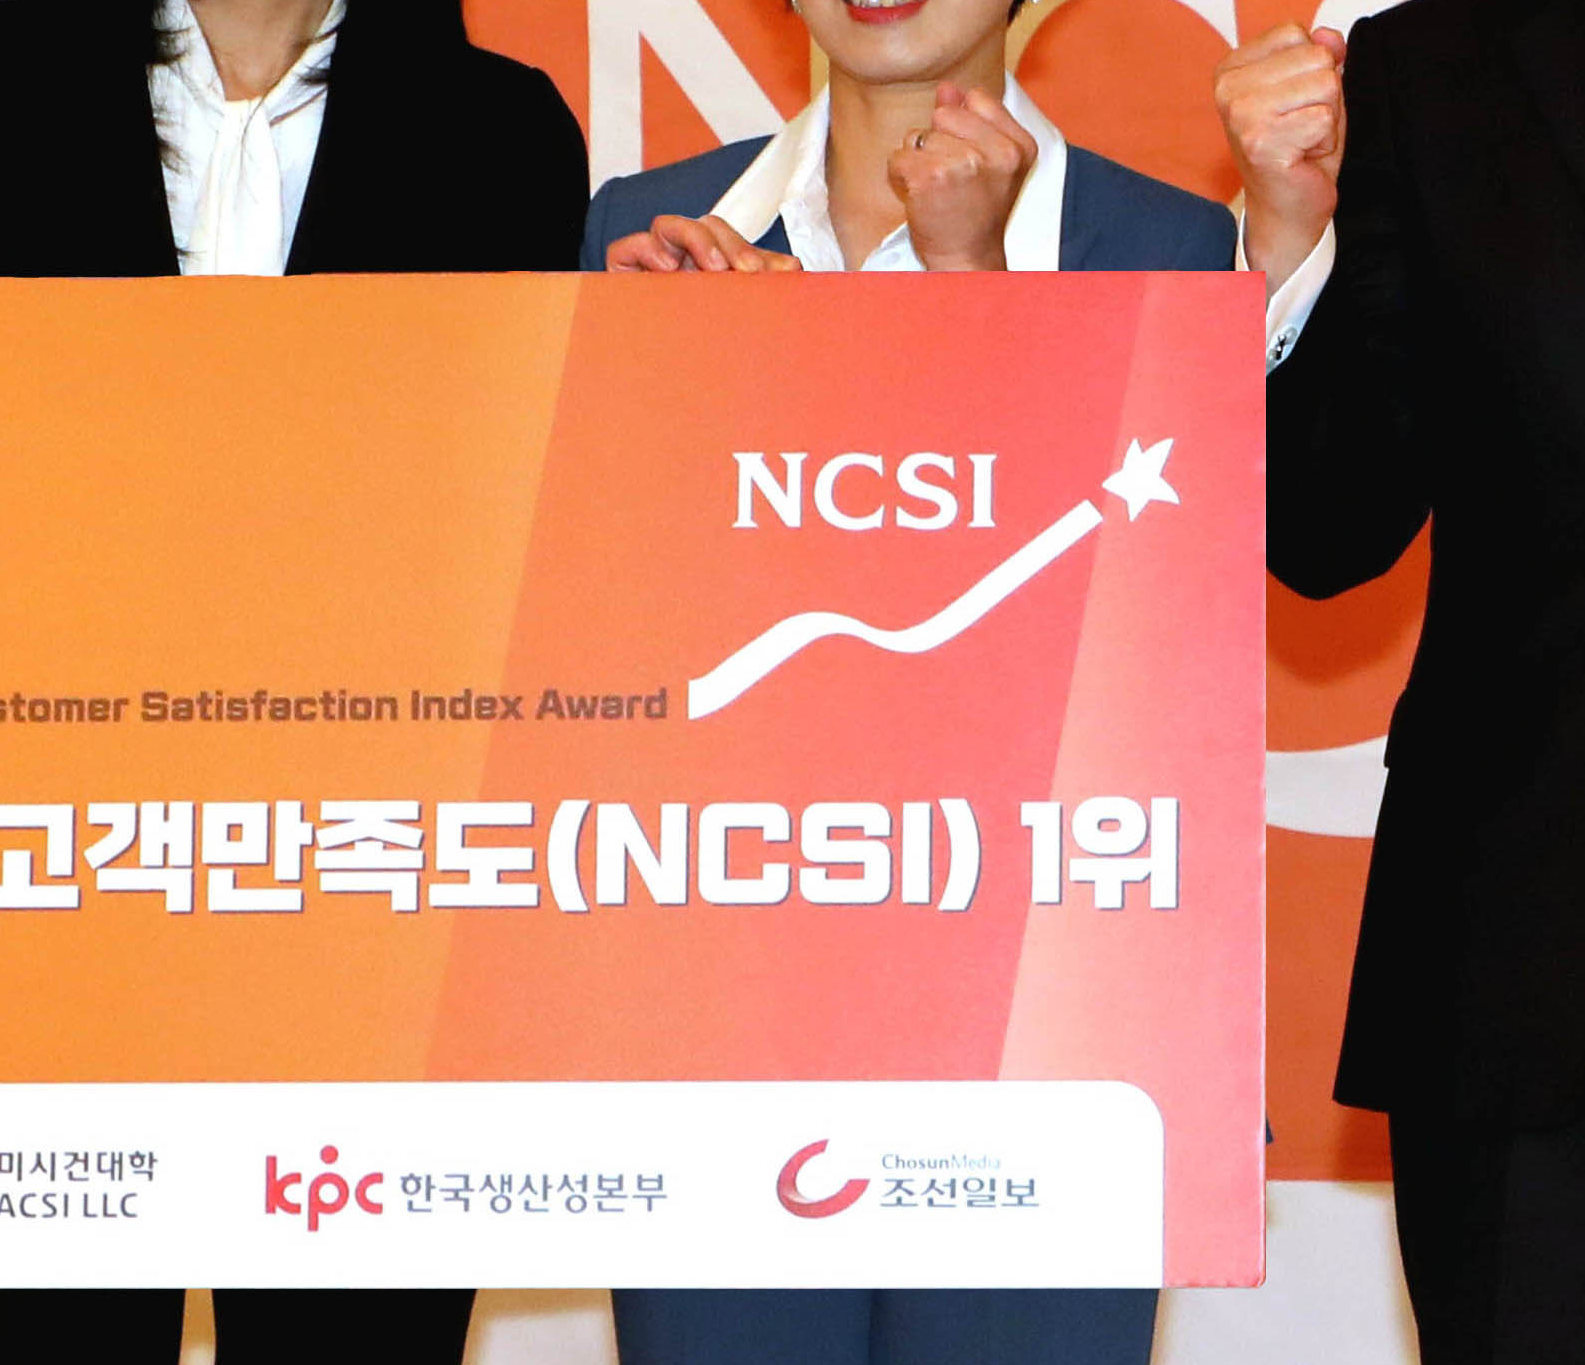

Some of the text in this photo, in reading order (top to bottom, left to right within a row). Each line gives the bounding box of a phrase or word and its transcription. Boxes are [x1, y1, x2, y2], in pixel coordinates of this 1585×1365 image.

[732, 451, 1000, 533] NCSI
[140, 689, 401, 724] Satisfaction
[410, 688, 525, 722] Index
[536, 687, 670, 721] Award
[1019, 795, 1181, 912] 1위
[82, 1192, 139, 1221] LLC
[265, 1144, 669, 1234] kpc 한국생산성본부
[879, 1176, 1041, 1211] 조선일보
